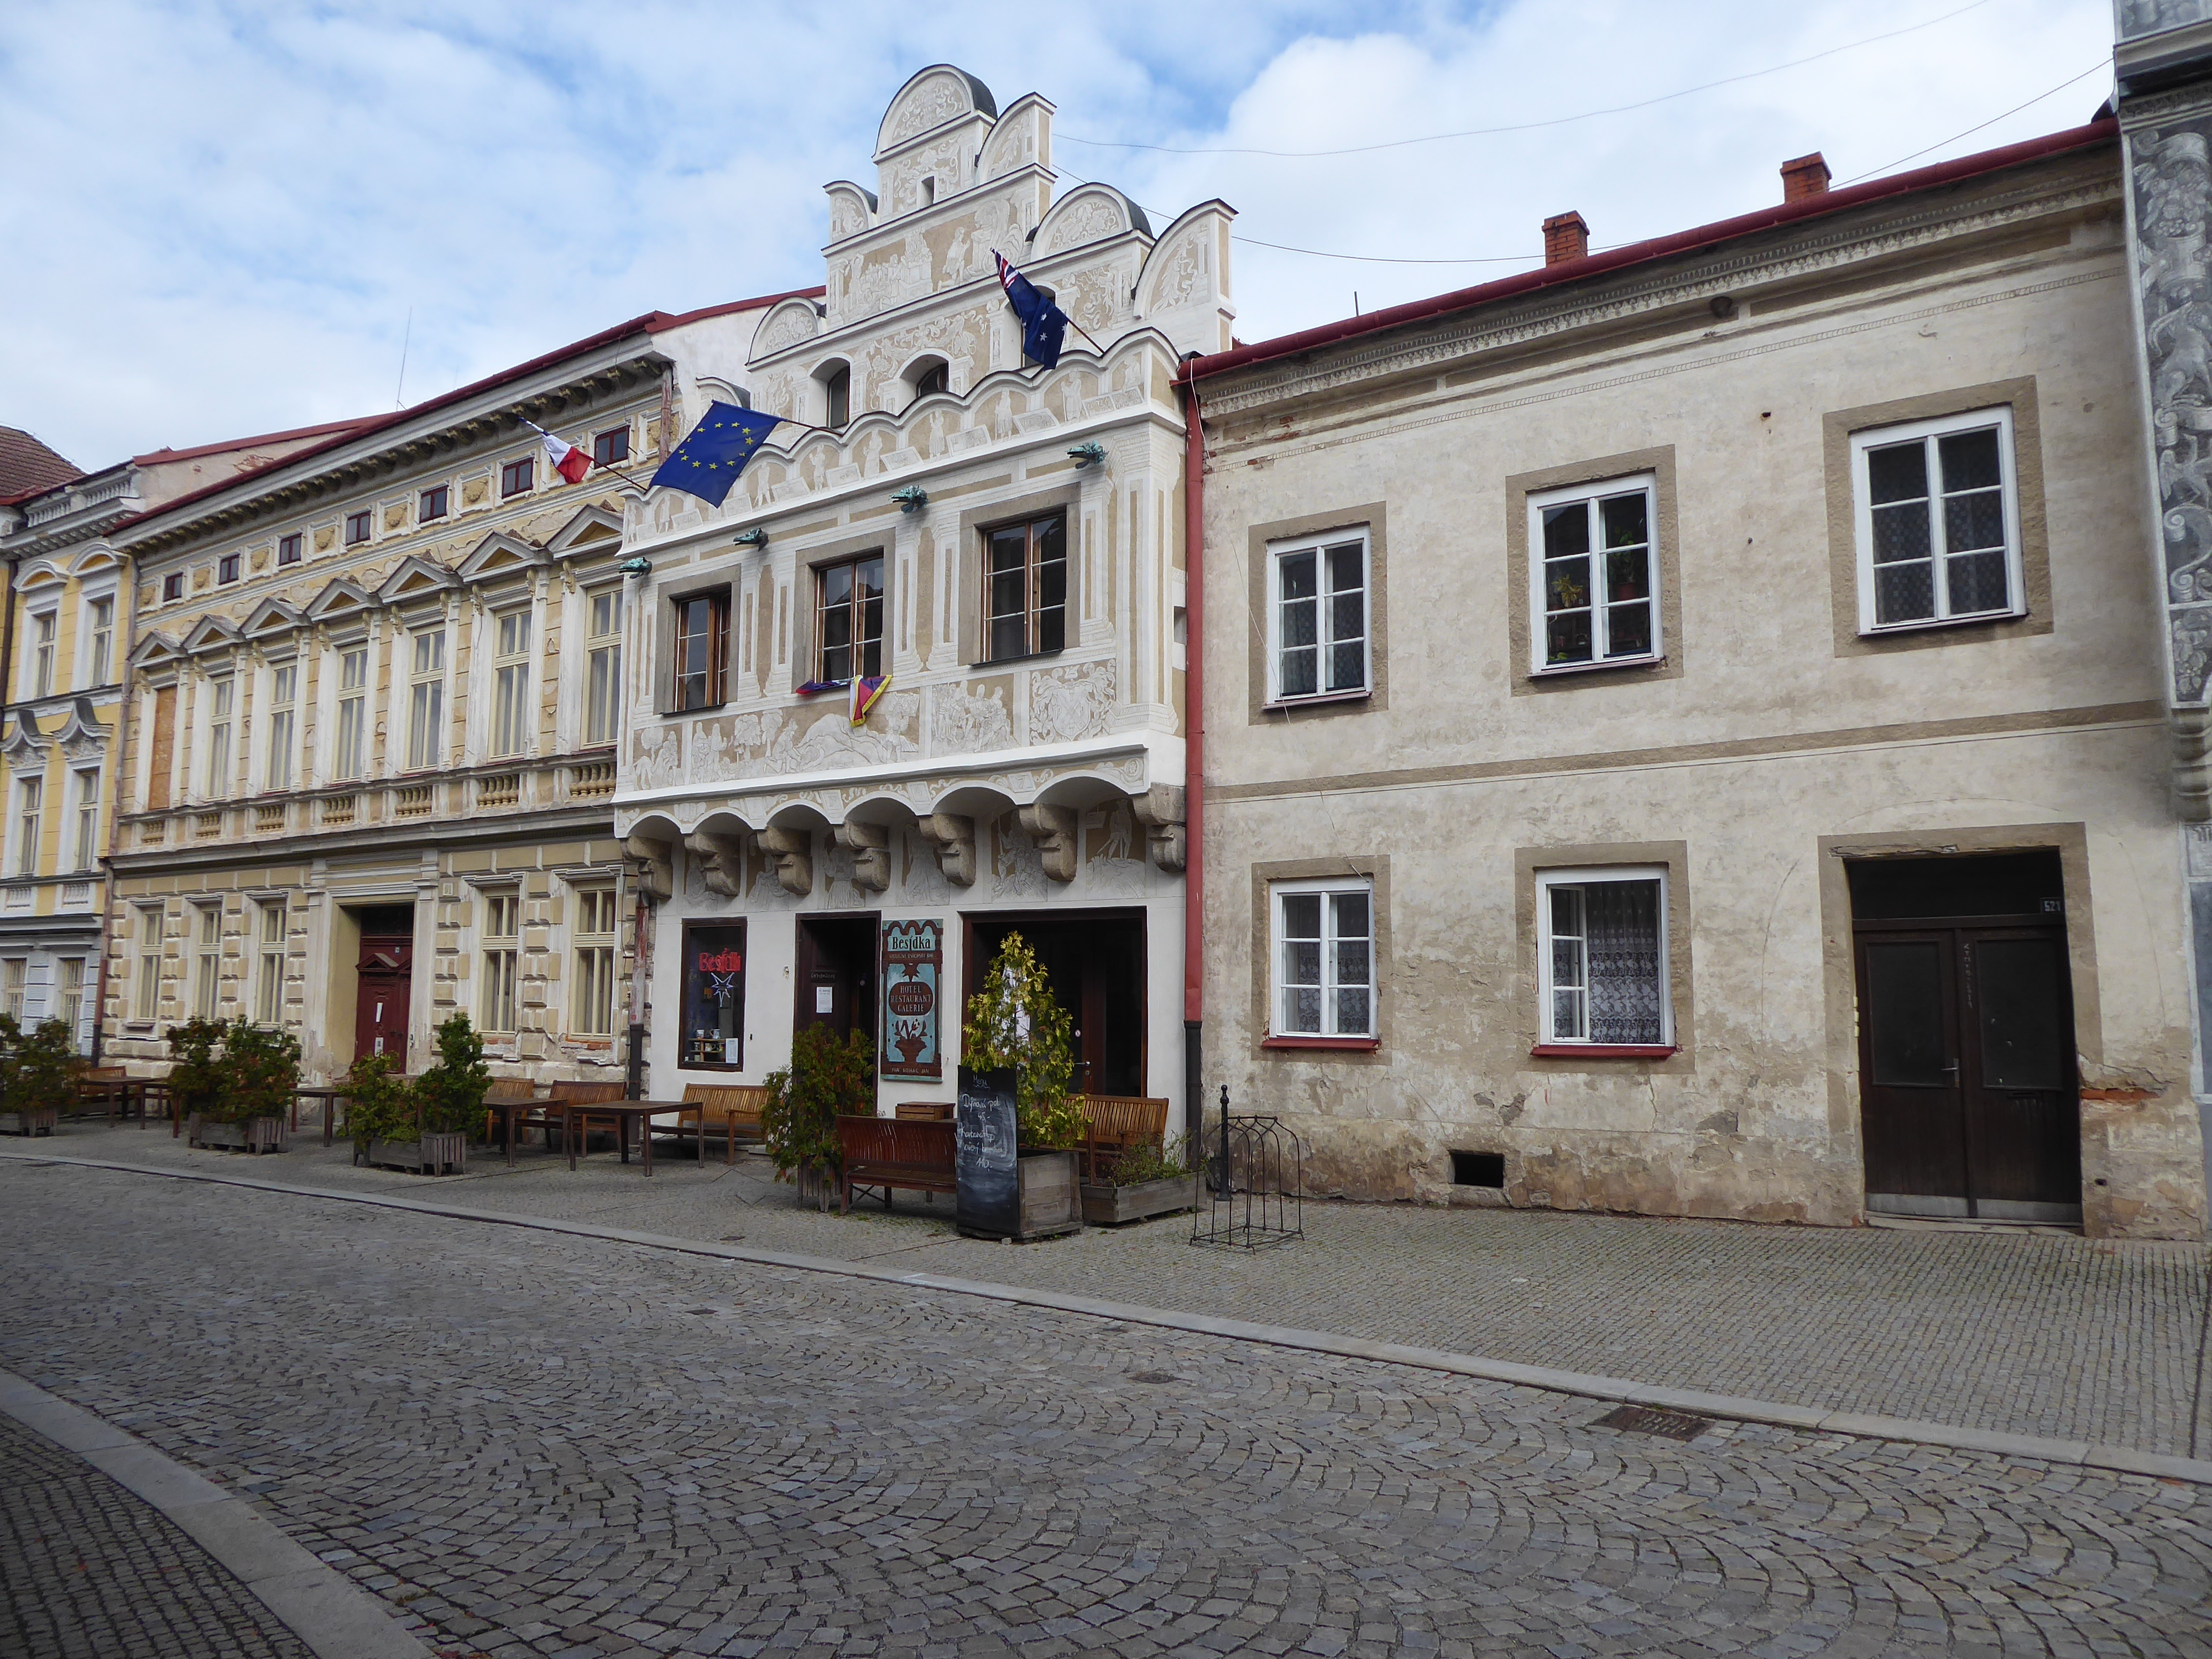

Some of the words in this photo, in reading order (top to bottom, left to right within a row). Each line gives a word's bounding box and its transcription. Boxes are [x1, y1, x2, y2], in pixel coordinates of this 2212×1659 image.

[2044, 900, 2060, 912] 521
[892, 936, 931, 951] Besídka
[900, 985, 922, 994] HOTEL
[890, 994, 931, 1003] RESTAURANT
[898, 1004, 925, 1013] GALERIE
